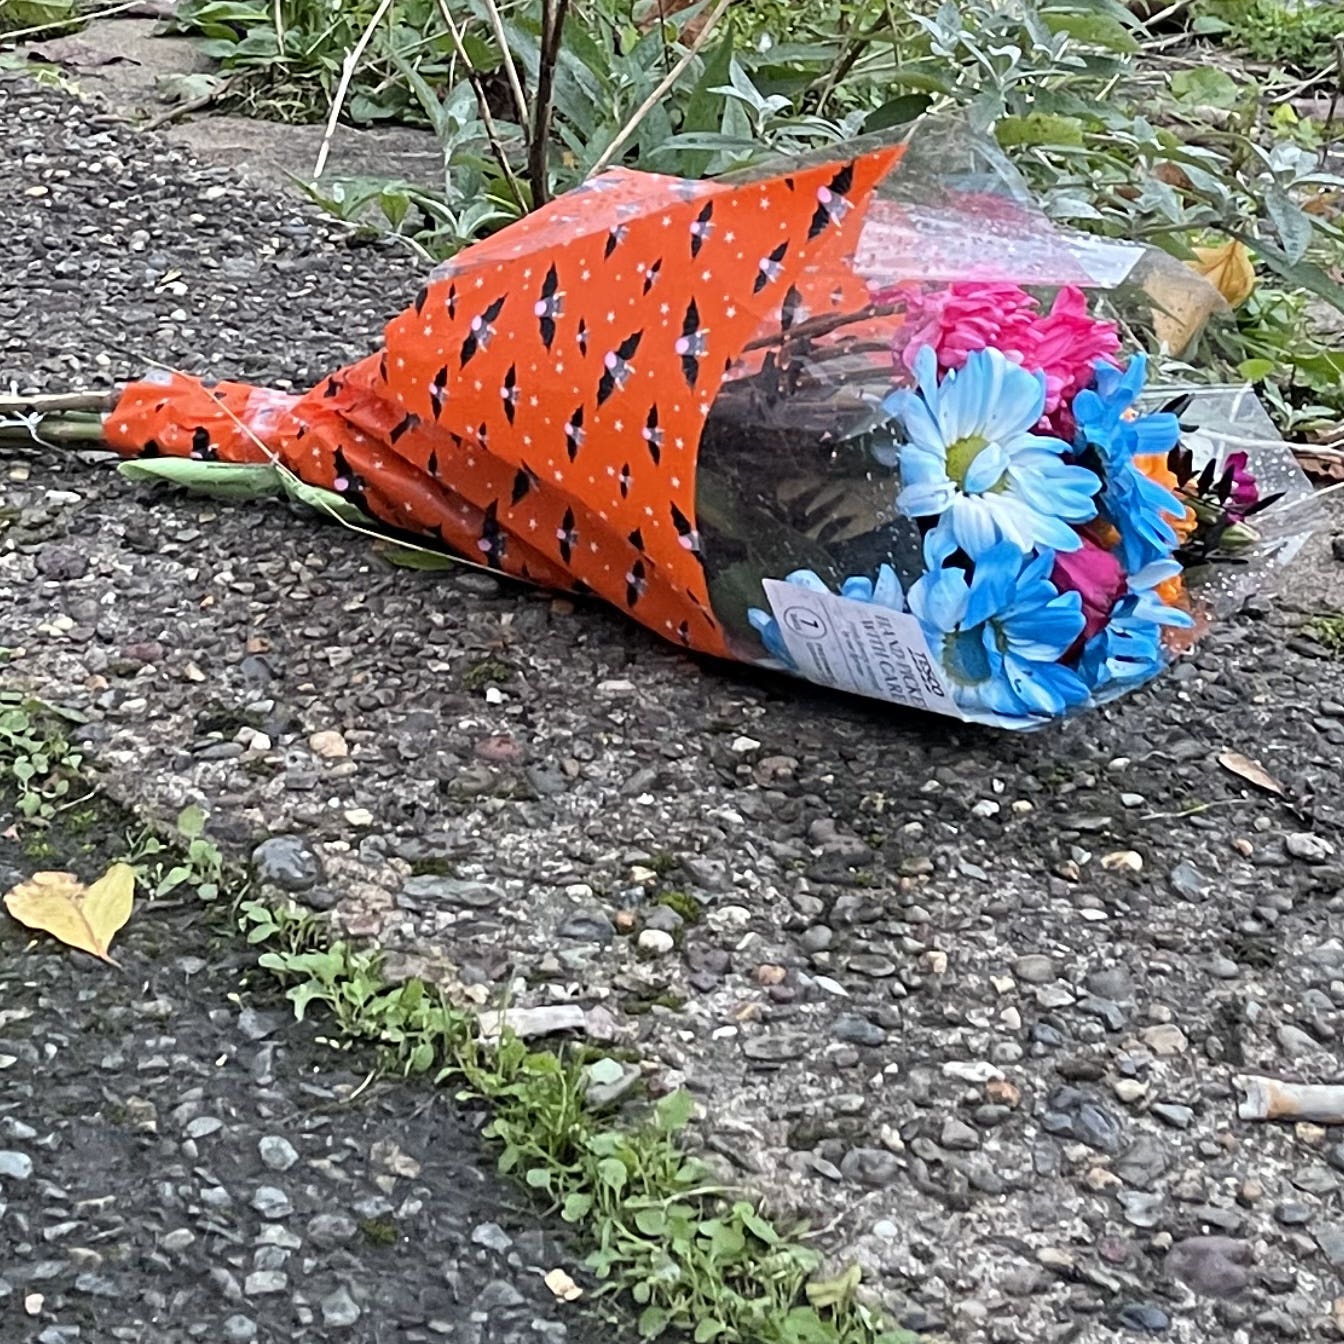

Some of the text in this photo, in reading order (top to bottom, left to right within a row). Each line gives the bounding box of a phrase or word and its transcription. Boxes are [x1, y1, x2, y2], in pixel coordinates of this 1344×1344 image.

[861, 620, 888, 660] WITH
[880, 659, 909, 702] CARE
[874, 614, 906, 662] HAND
[915, 651, 945, 697] TESCO
